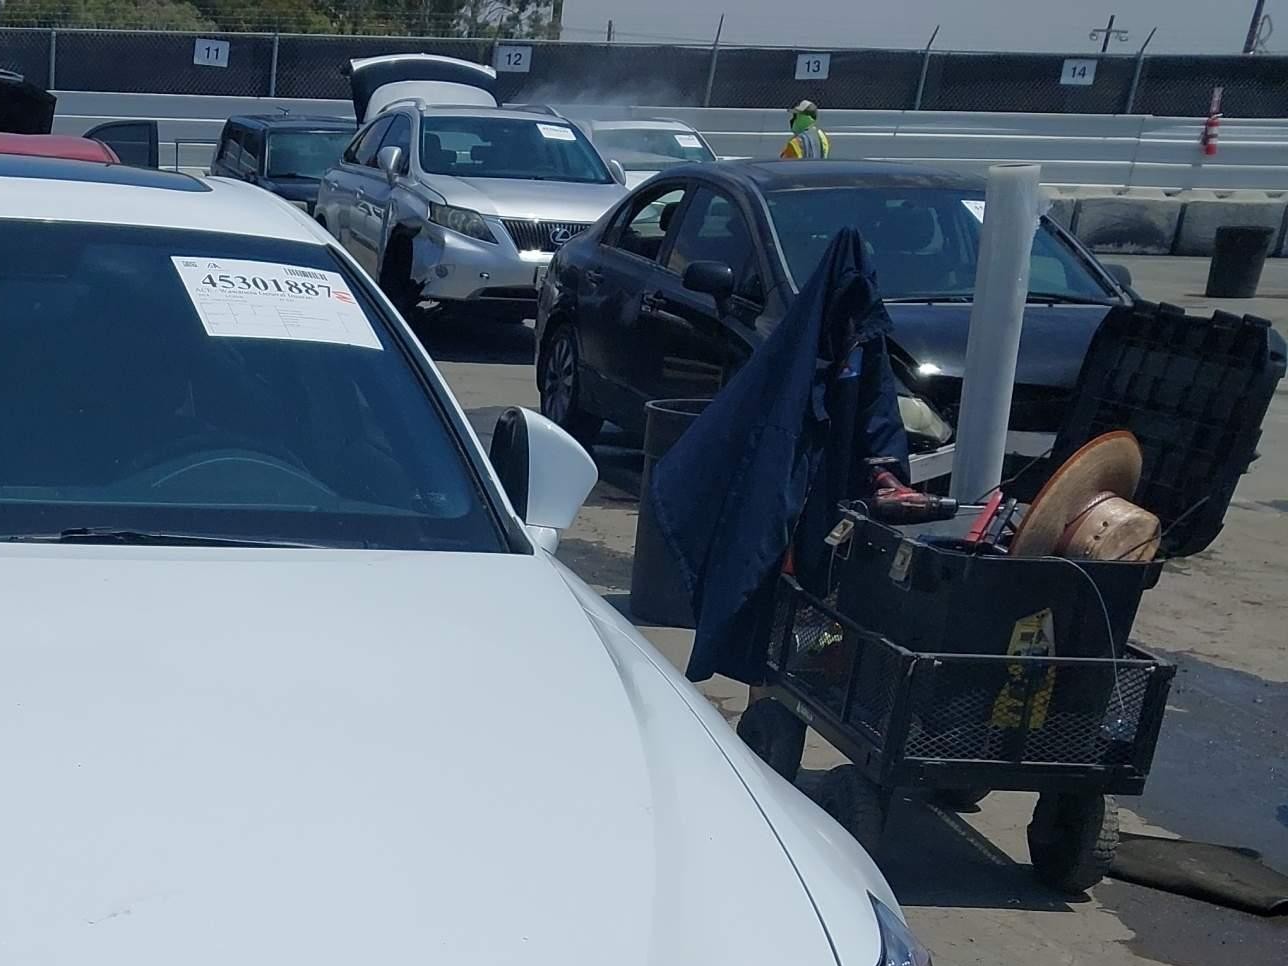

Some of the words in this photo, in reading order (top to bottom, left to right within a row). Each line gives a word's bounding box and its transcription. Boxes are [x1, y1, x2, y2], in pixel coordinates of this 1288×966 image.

[205, 46, 220, 60] 11
[506, 52, 522, 66] 12
[805, 60, 821, 73] 13
[1071, 66, 1087, 79] 14
[201, 273, 332, 298] 45301887
